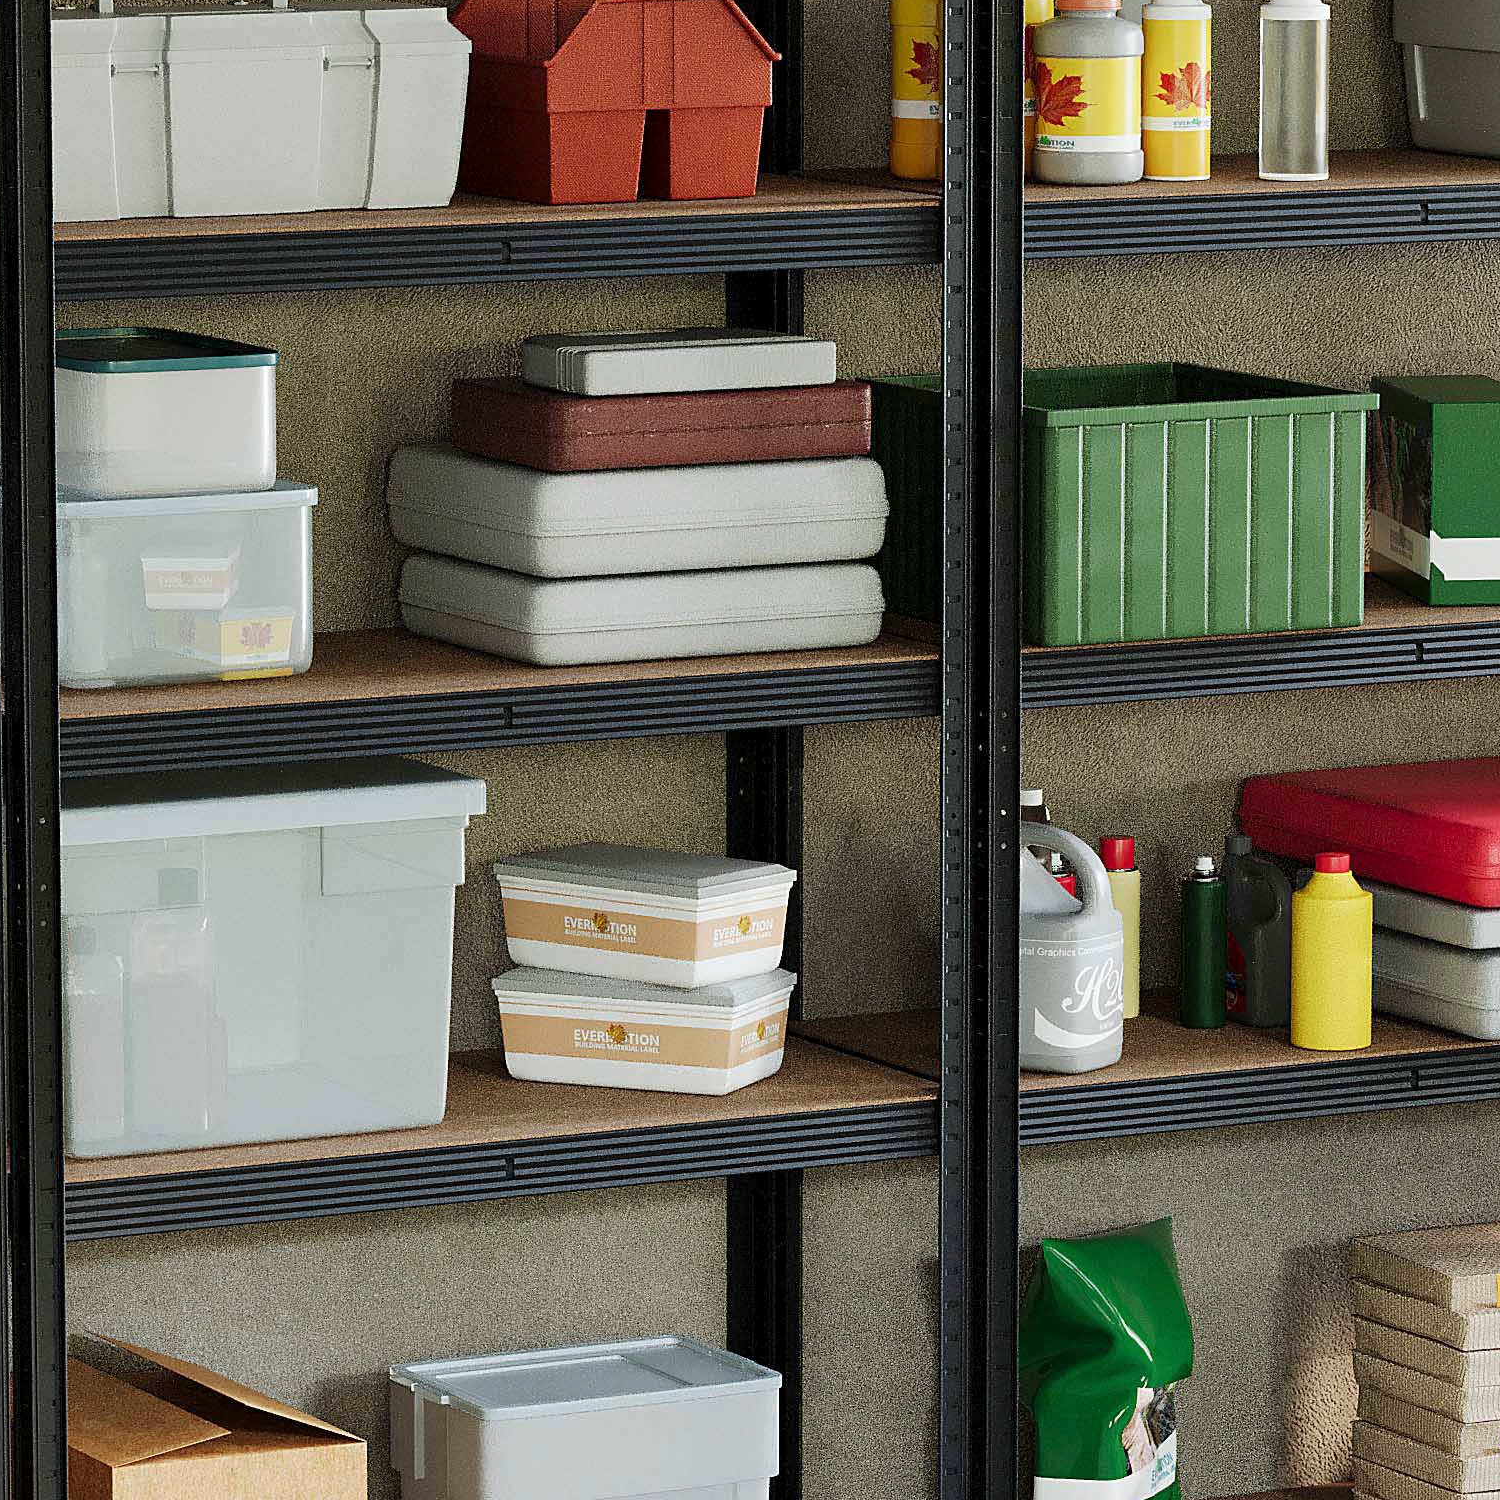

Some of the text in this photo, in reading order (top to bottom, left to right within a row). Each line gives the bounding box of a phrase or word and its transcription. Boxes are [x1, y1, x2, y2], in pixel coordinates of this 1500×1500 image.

[564, 916, 637, 937] EVERTION
[713, 918, 773, 941] EVERTION
[1036, 947, 1076, 957] Graphics
[574, 1028, 660, 1046] EVERTION
[640, 1046, 660, 1054] LABEL
